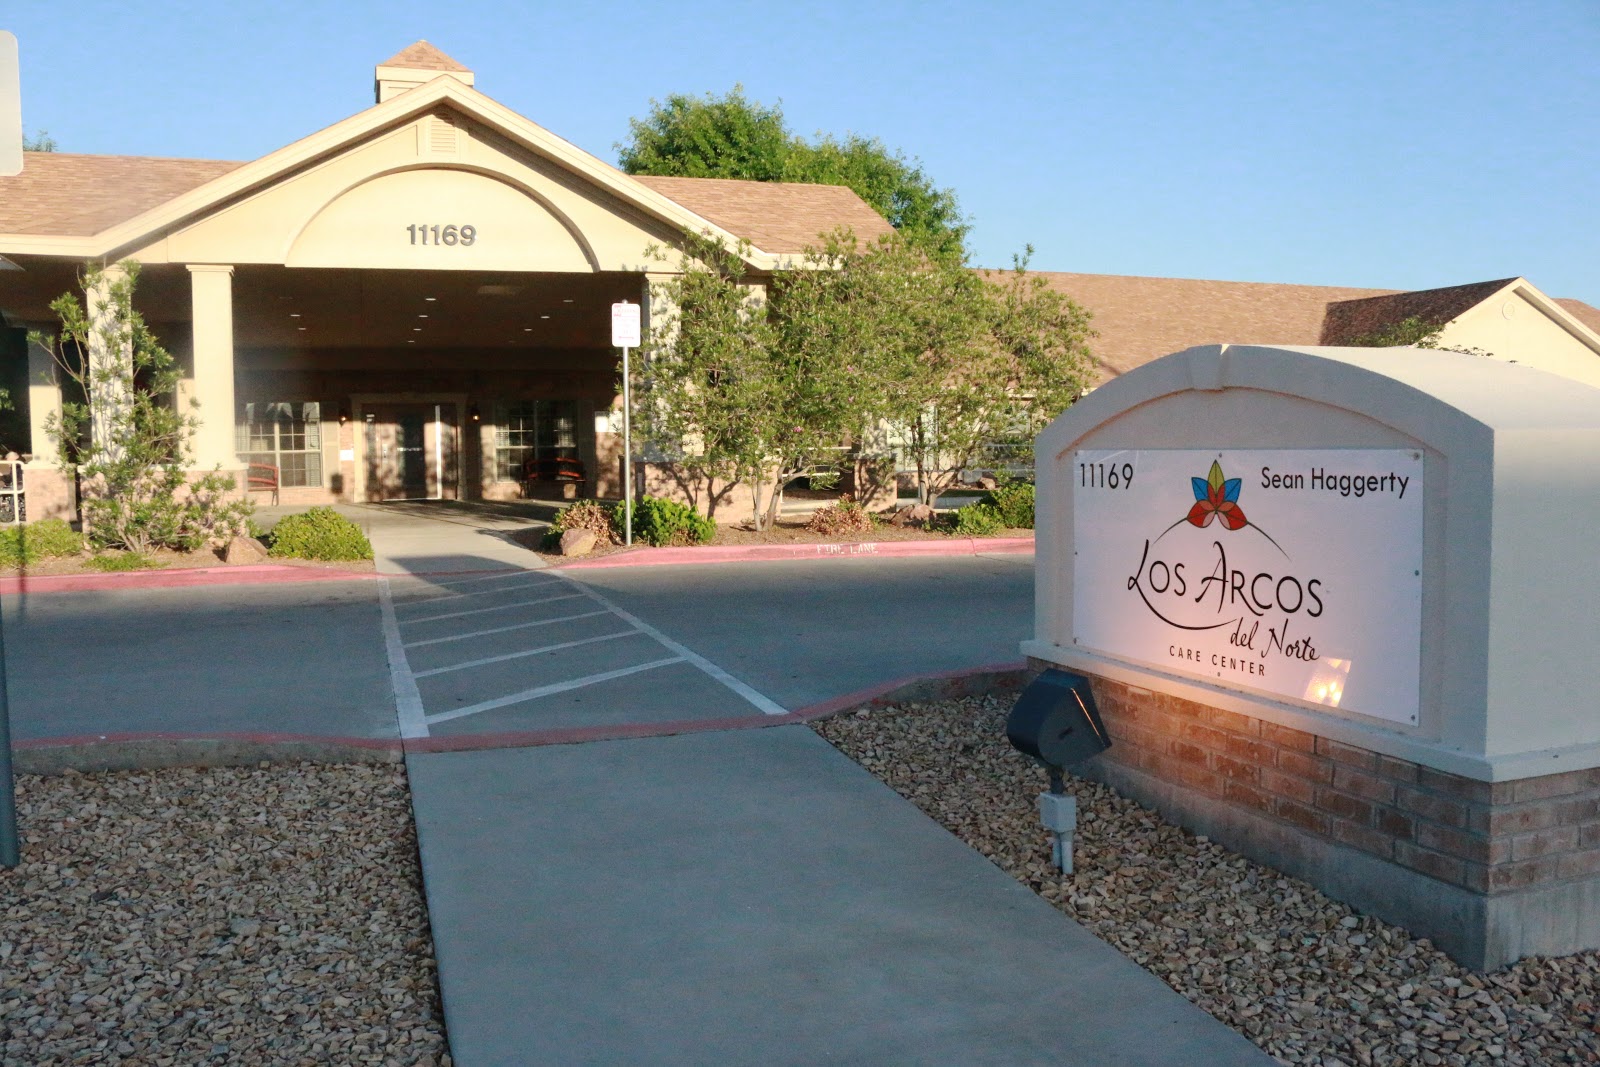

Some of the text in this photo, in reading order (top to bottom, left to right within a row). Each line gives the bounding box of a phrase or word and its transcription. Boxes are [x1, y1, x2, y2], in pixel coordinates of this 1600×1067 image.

[406, 224, 476, 246] 11169
[1080, 463, 1134, 489] 11169
[1261, 467, 1409, 498] Sean Haggerty
[817, 543, 879, 554] FIRE LANE
[1128, 539, 1324, 628] LOS ARCOS
[1230, 618, 1320, 662] del Norte
[1170, 645, 1266, 676] CARE CENTER
